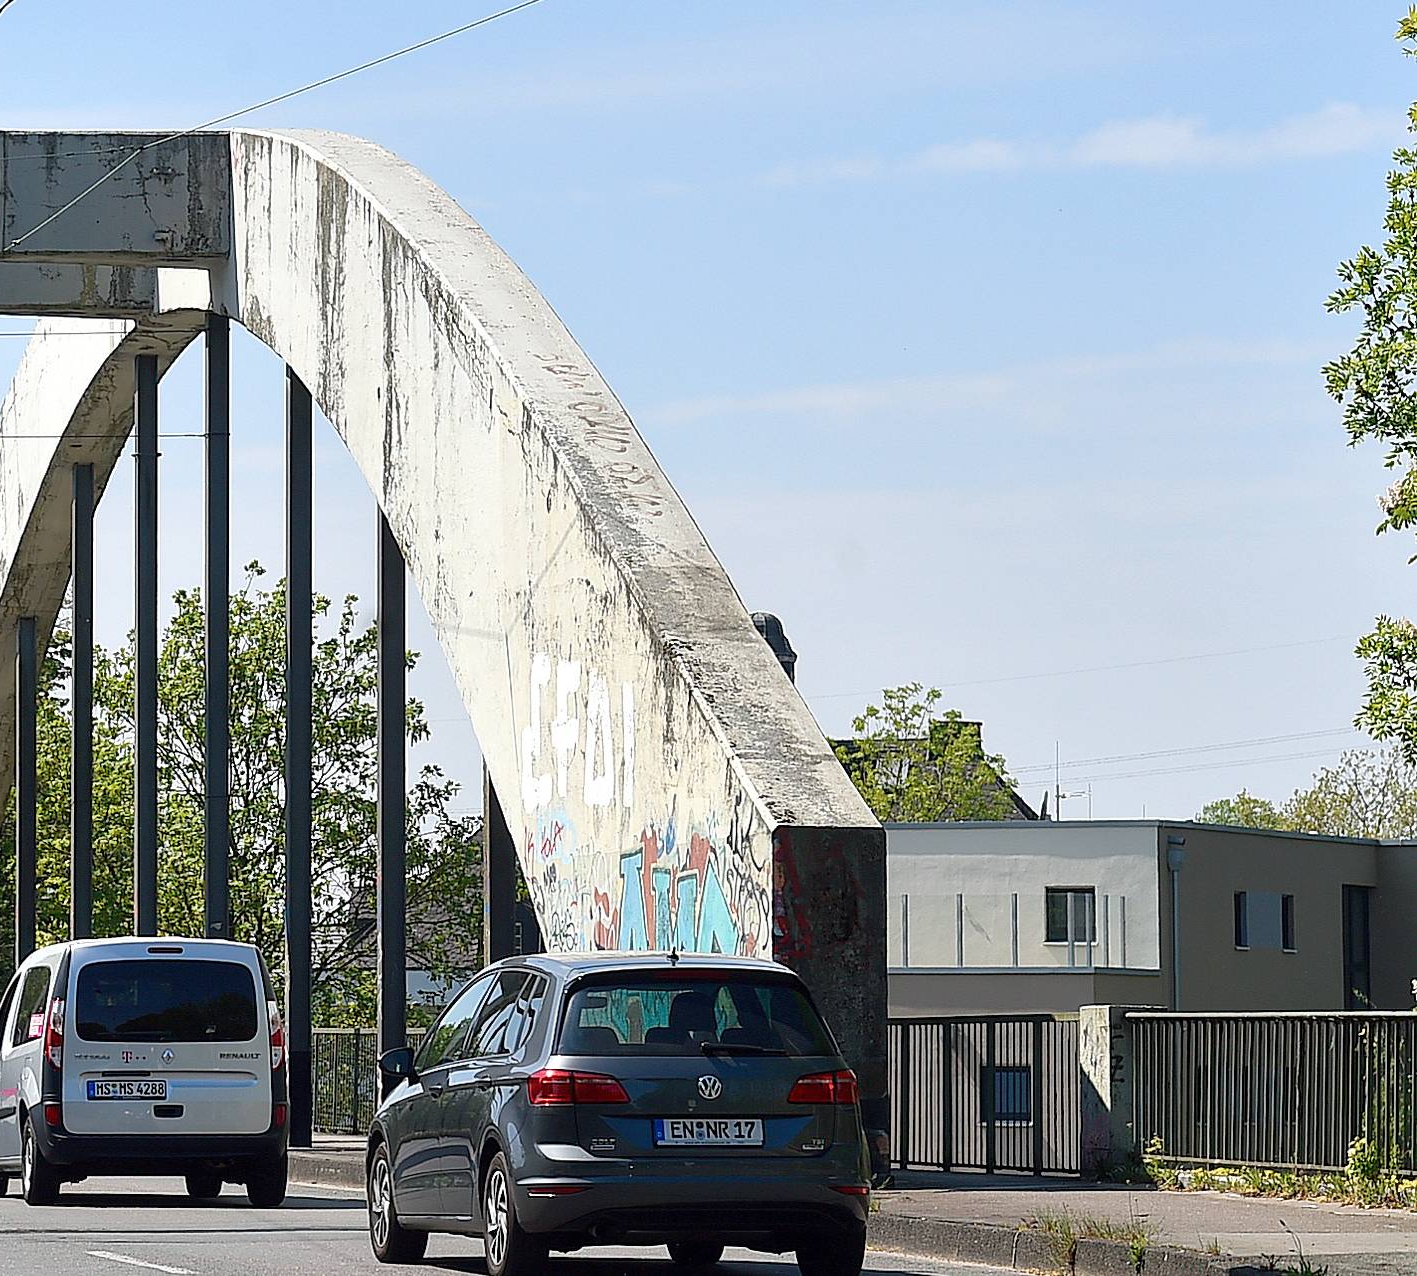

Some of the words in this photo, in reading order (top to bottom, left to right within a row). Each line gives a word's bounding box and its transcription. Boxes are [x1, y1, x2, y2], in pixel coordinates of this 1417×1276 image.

[219, 1052, 261, 1060] RENAULT
[96, 1083, 111, 1095] MS
[119, 1083, 133, 1095] MS
[137, 1083, 164, 1095] 4288
[670, 1121, 695, 1139] EN
[706, 1121, 730, 1139] NR
[733, 1121, 756, 1139] 17
